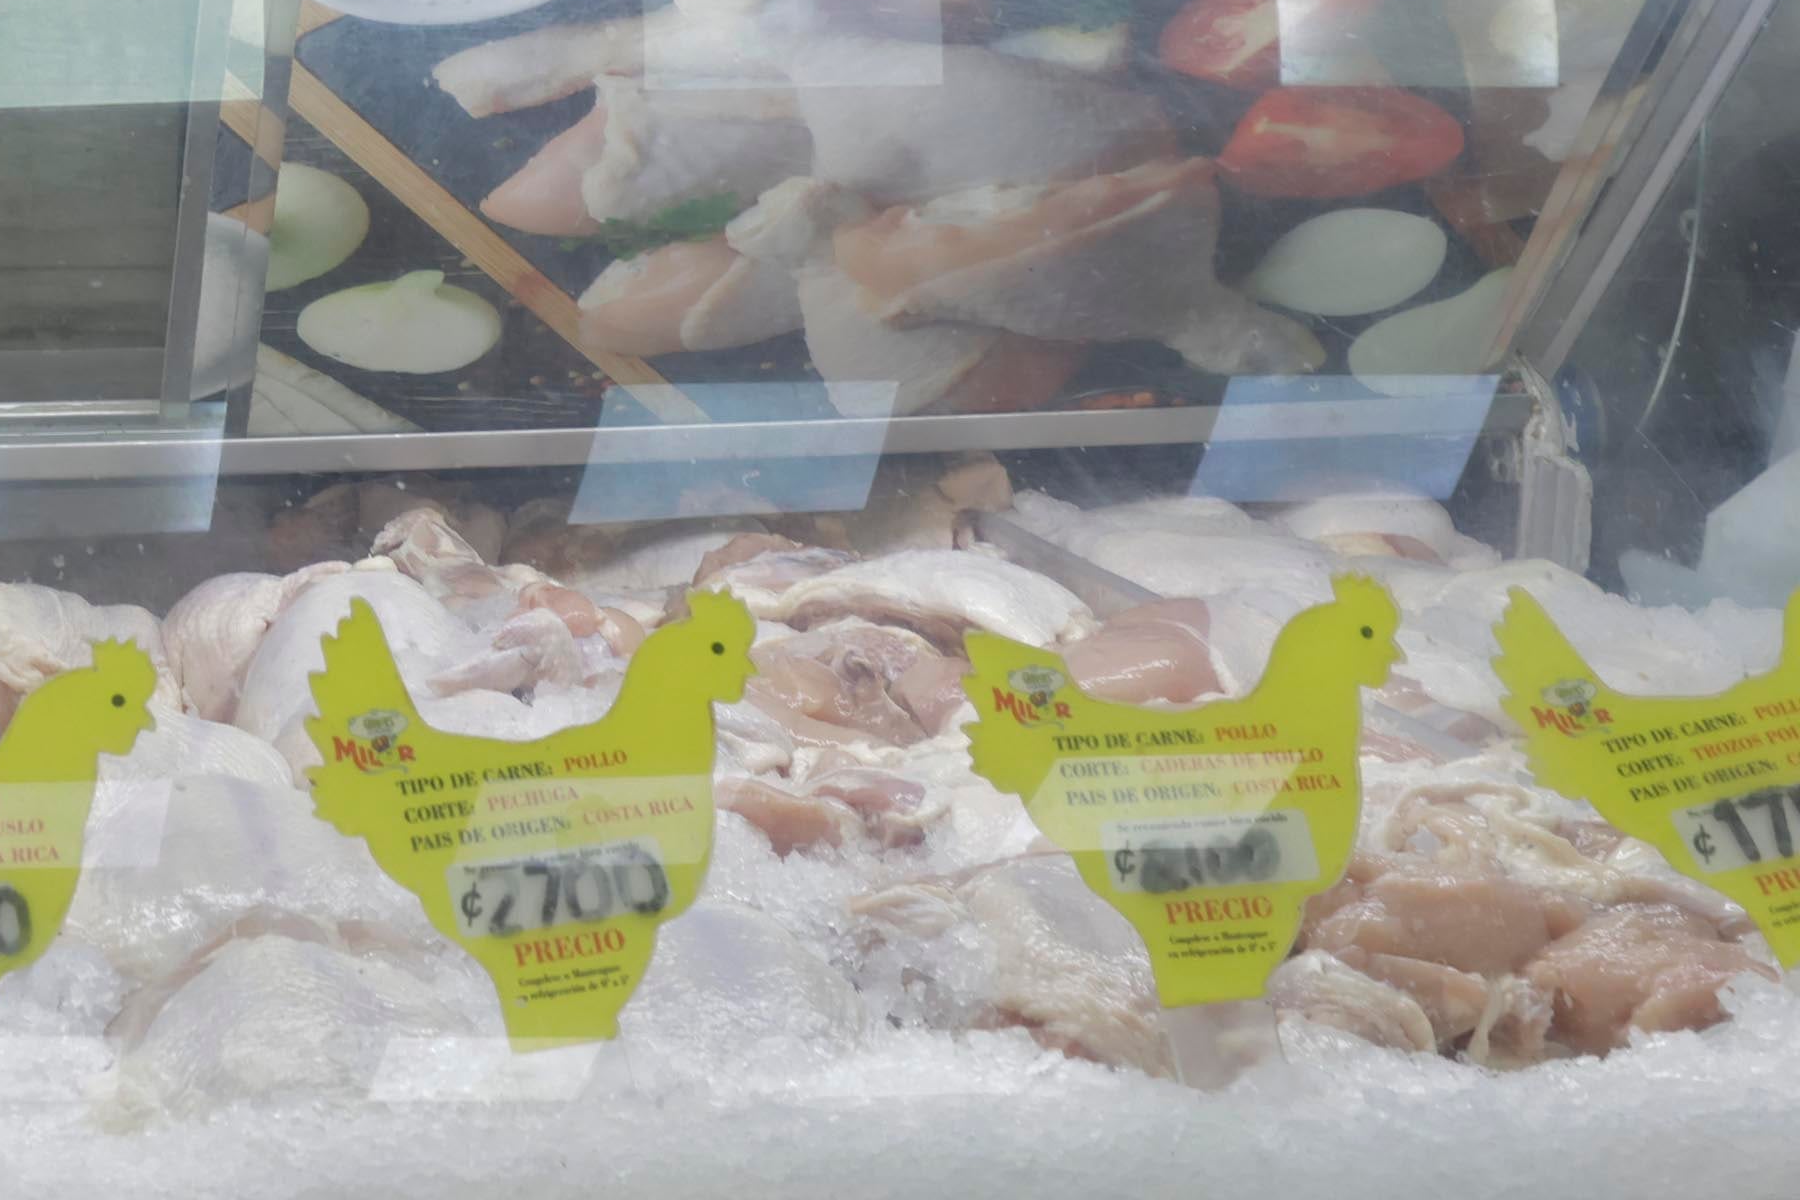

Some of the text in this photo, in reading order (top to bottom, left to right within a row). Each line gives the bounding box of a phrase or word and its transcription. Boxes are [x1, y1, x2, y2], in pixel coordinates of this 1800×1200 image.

[1052, 723, 1277, 752] TIPO DE CARNE: POLLO
[1603, 733, 1647, 754] TIPO
[1650, 726, 1678, 744] DE
[1680, 712, 1747, 737] CARNE:
[396, 750, 628, 796] TIPO DE CARNE: POLLO
[1060, 747, 1324, 779] CORTE: CADERAS DE POLLO
[1617, 752, 1684, 778] CORTE:
[1691, 733, 1762, 761] TROZOS
[1065, 774, 1341, 807] PAIS DE ORIGEN: COSTA RICA
[1629, 759, 1777, 803] PAIS DE ORIGEN:
[404, 786, 579, 824] CORTE: PECHUGA
[410, 797, 695, 852] PAIS DE ORIGEN: COSTA RICA
[11, 846, 59, 863] RICA
[1166, 895, 1273, 925] PRECIO
[514, 928, 625, 968] PRECIO
